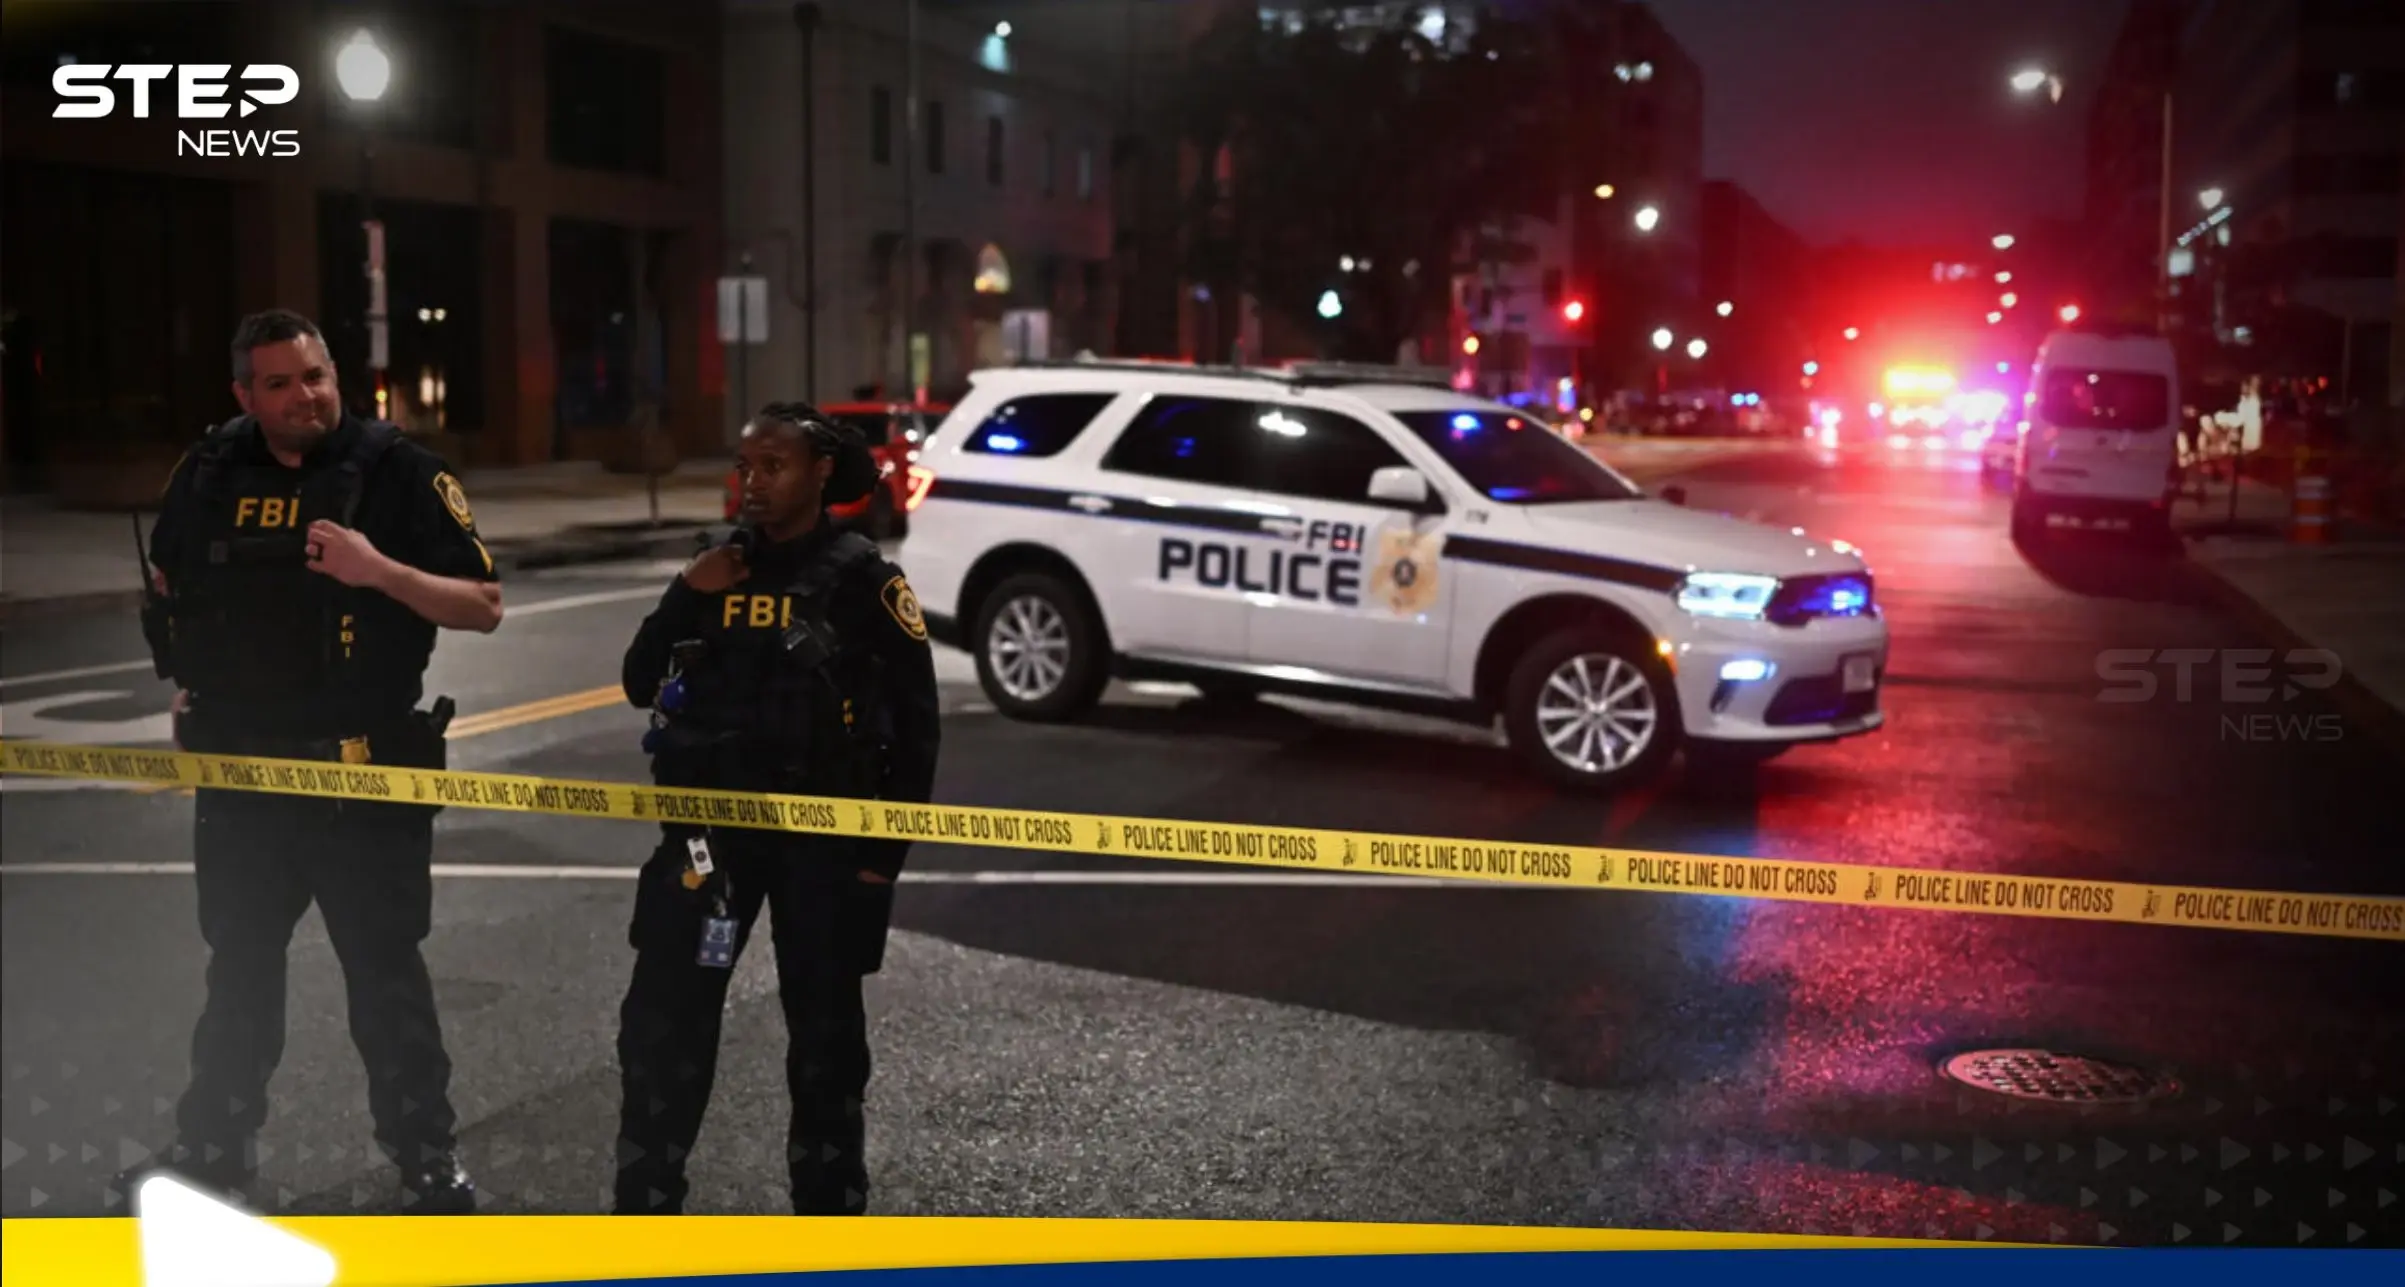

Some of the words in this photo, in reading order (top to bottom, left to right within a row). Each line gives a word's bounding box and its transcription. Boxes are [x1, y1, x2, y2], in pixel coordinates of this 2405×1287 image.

[235, 497, 299, 528] FBI
[1306, 519, 1365, 554] FBI
[1158, 536, 1361, 606] POLICE
[723, 594, 792, 630] FBI
[220, 763, 265, 786] POLICE
[266, 766, 297, 789] LINE
[297, 768, 318, 791] DO
[317, 770, 344, 793] NOT
[346, 771, 390, 796] CROSS
[434, 778, 480, 803] POLICE
[481, 780, 512, 805] LINE
[513, 783, 533, 807] DO
[533, 785, 560, 809] NOT
[563, 786, 609, 812] CROSS
[654, 794, 702, 818] POLICE
[702, 797, 736, 820] LINE
[737, 799, 757, 823] DO
[759, 801, 787, 825] NOT
[788, 802, 836, 828] CROSS
[884, 809, 934, 835] POLICE
[935, 812, 967, 838] LINE
[970, 815, 990, 839] DO
[992, 817, 1021, 841] NOT
[1025, 818, 1072, 845] CROSS
[1123, 825, 1173, 852] POLICE
[1176, 828, 1208, 854] LINE
[1211, 831, 1232, 856] DO
[1235, 833, 1264, 858] NOT
[1267, 834, 1317, 861] CROSS
[1370, 841, 1421, 868] POLICE
[1425, 844, 1458, 870] LINE
[1461, 847, 1482, 873] DO
[1487, 848, 1517, 874] NOT
[1520, 850, 1571, 878] CROSS
[1627, 858, 1681, 885] POLICE
[1684, 861, 1718, 888] LINE
[1722, 864, 1744, 890] DO
[1748, 865, 1780, 892] NOT
[1783, 867, 1837, 896] CROSS
[1895, 875, 1952, 903] POLICE
[1954, 878, 1990, 906] LINE
[1994, 881, 2018, 908] DO
[2021, 883, 2055, 910] NOT
[2058, 885, 2115, 914] CROSS
[2174, 892, 2235, 921] POLICE
[2236, 896, 2272, 924] LINE
[2277, 899, 2303, 926] DO
[2306, 901, 2344, 928] NOT
[2344, 902, 2404, 933] CROSS
